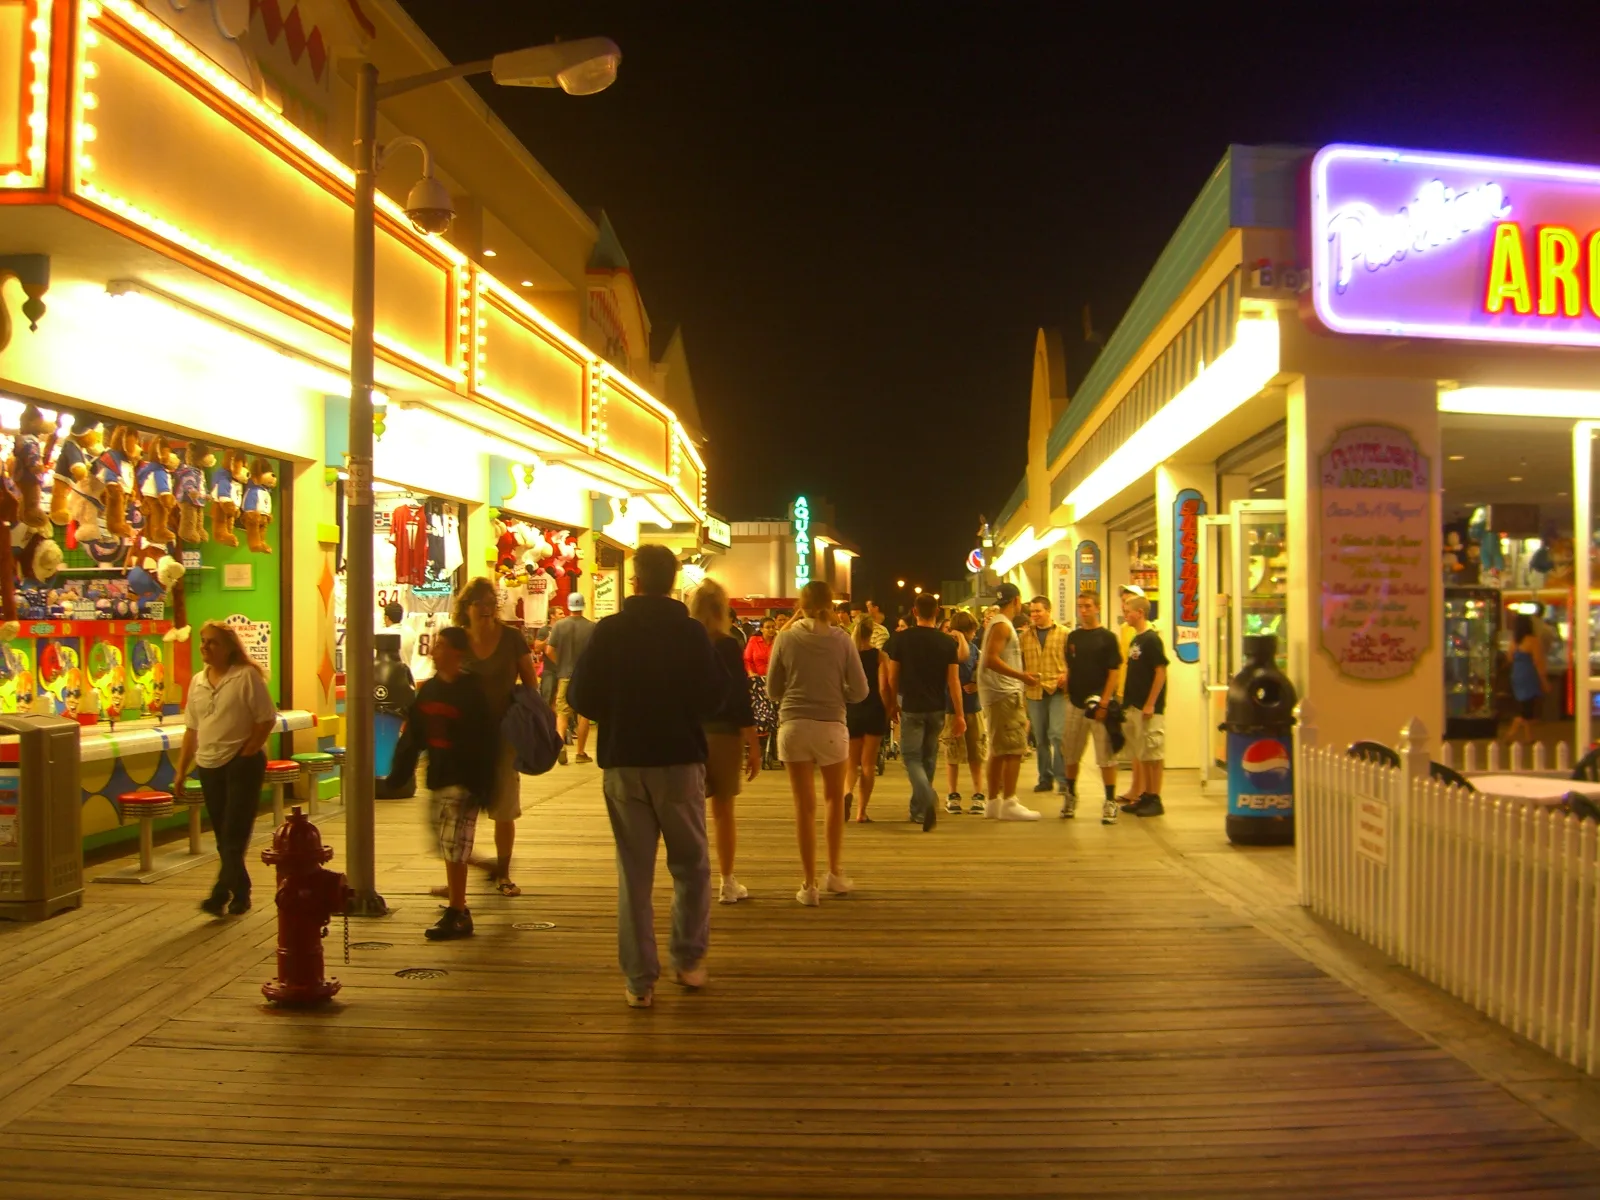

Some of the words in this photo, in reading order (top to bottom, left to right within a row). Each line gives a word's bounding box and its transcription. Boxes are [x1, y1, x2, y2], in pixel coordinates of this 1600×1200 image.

[1340, 468, 1414, 489] ARCADE
[794, 496, 810, 590] AQUARIUM
[1080, 579, 1098, 592] SLOT
[1180, 631, 1199, 640] ATM
